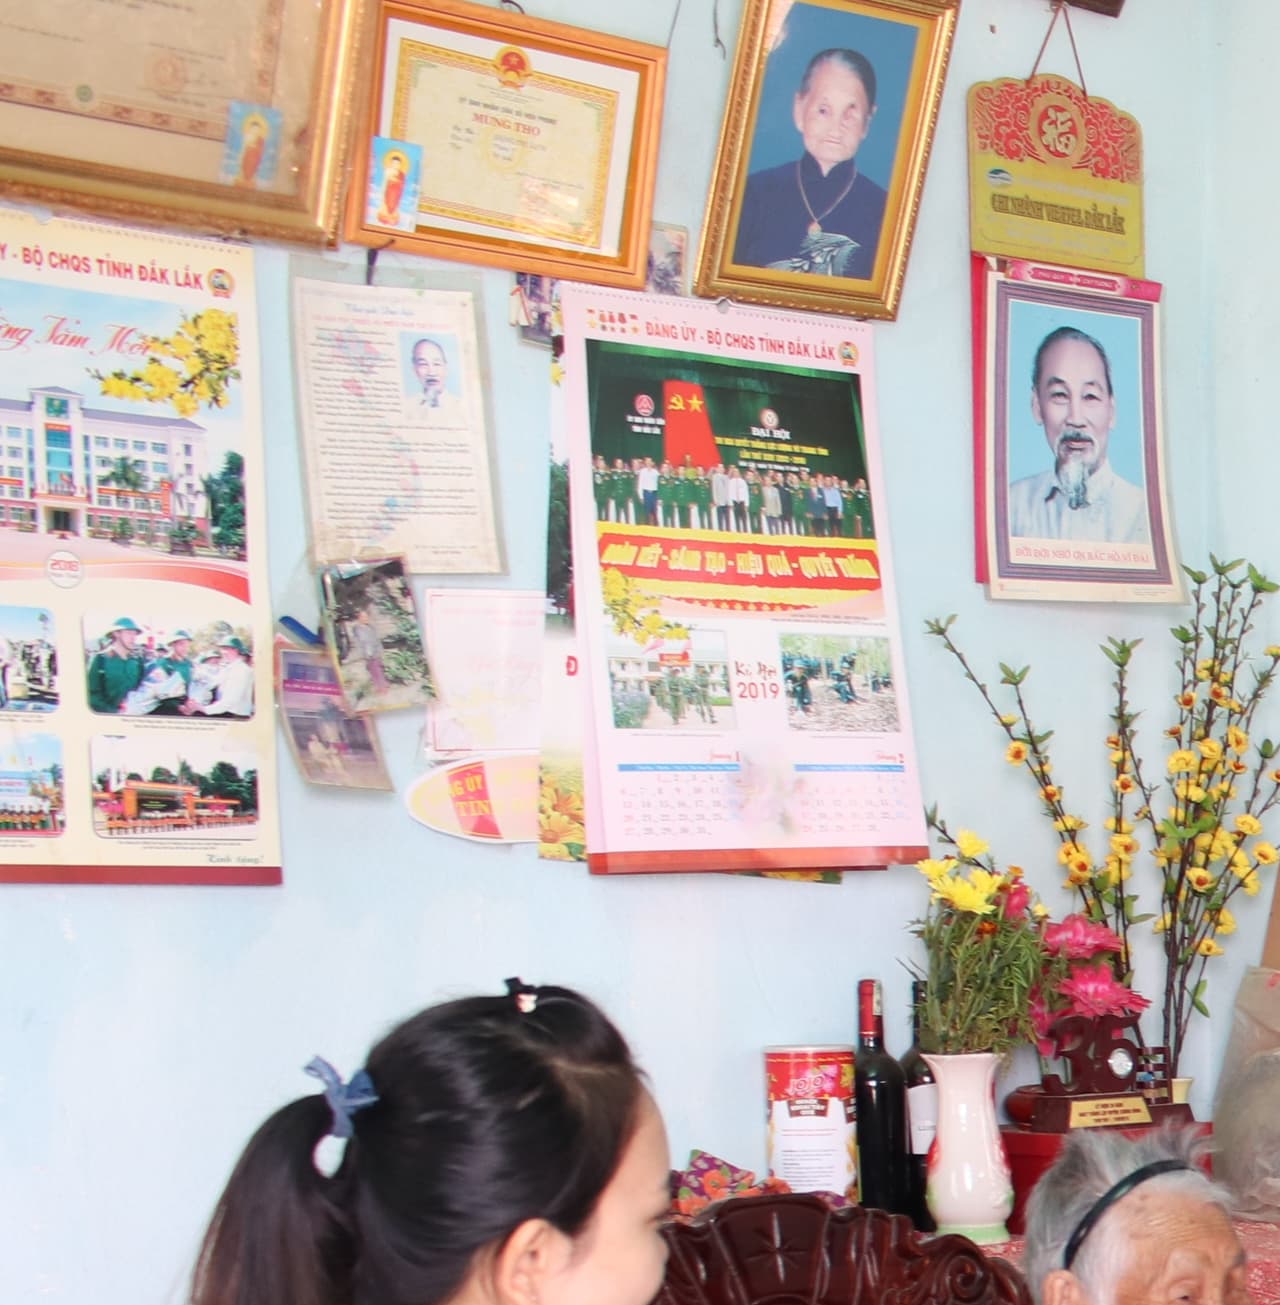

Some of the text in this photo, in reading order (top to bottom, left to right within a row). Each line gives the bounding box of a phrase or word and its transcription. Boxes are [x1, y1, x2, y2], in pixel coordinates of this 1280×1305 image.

[22, 245, 43, 271] BỘ
[49, 251, 91, 274] CHQS
[96, 253, 134, 280] TỈNH
[707, 328, 722, 350] BỘ
[725, 333, 755, 352] CHQS
[759, 333, 785, 355] TỈNH
[736, 681, 780, 699] 2019
